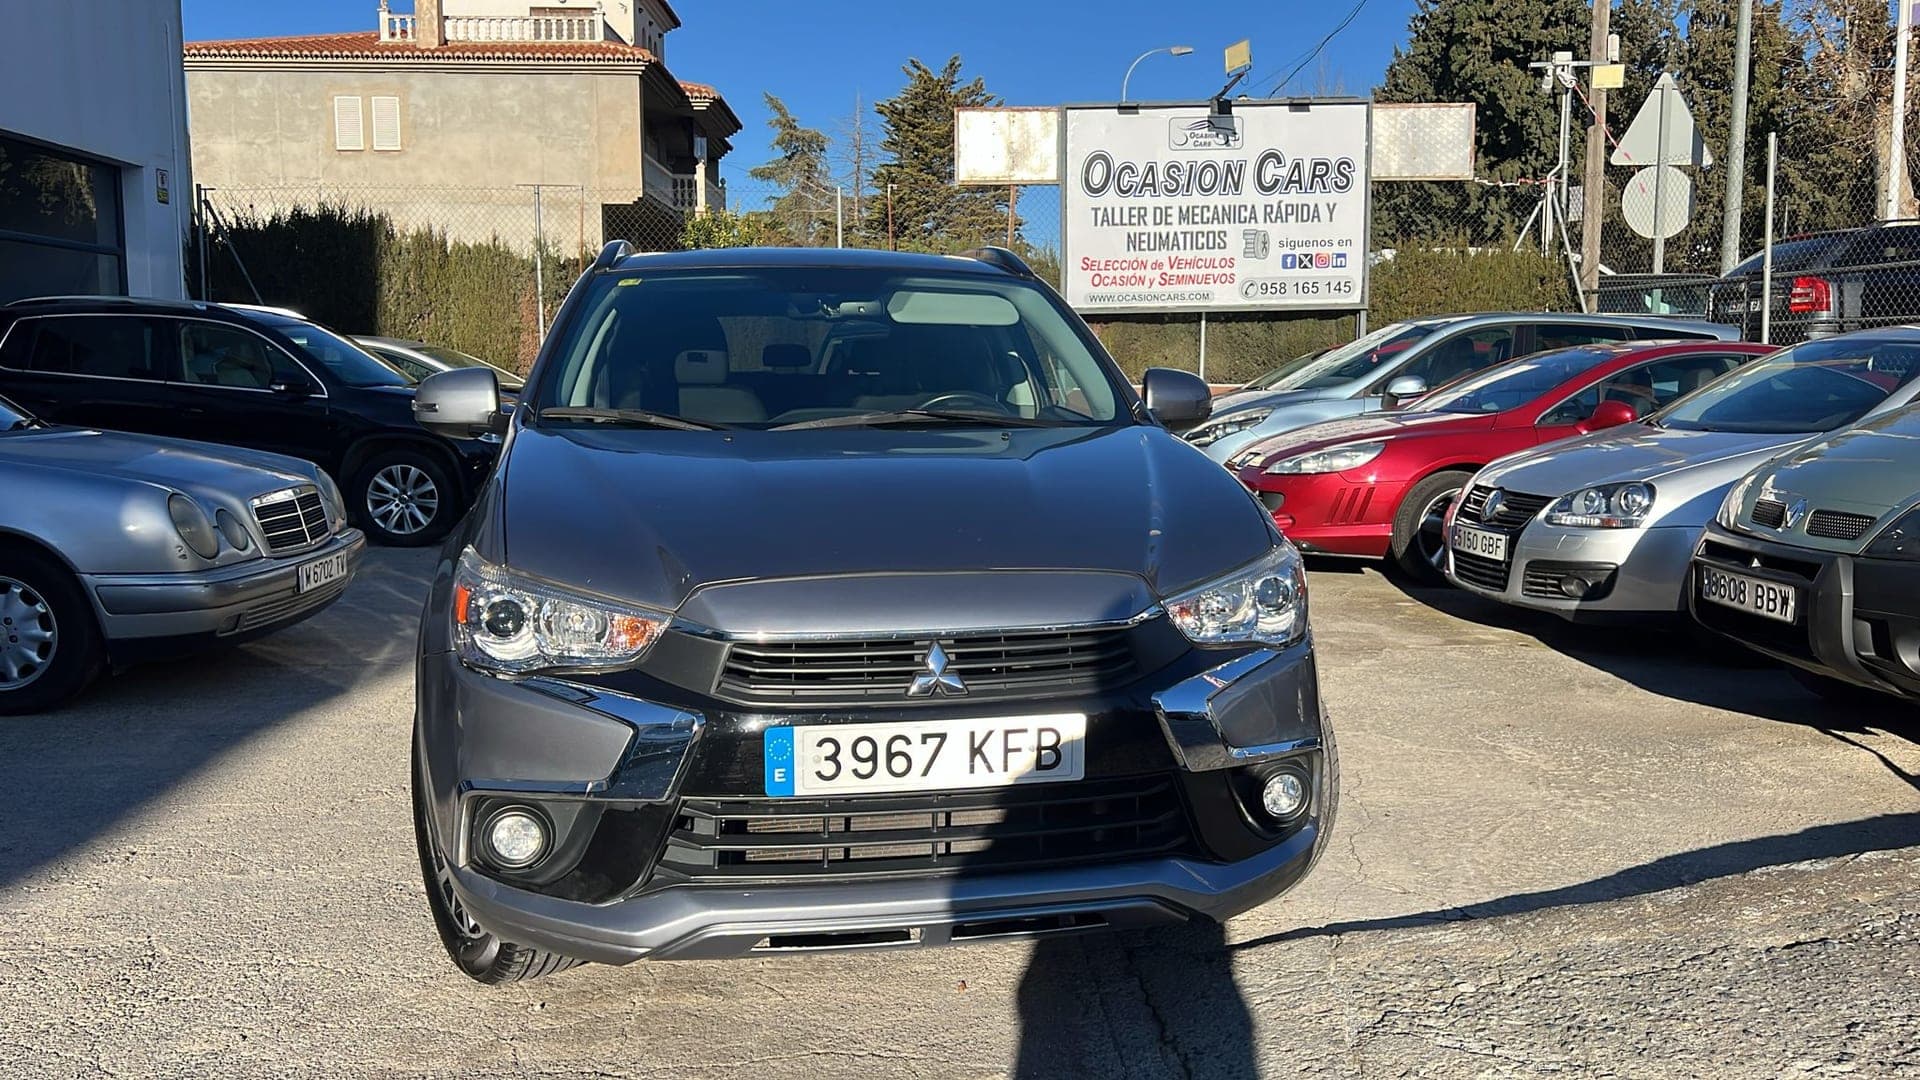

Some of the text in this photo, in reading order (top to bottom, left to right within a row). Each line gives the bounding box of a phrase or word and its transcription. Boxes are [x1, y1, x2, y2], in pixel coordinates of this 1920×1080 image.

[1081, 148, 1355, 198] OCASION CARS
[1091, 200, 1337, 227] TALLER DE MECANICA RÁPIDA Y
[1126, 230, 1227, 252] NEUMATICOS
[1338, 239, 1352, 247] en
[1150, 260, 1164, 270] de
[1148, 278, 1155, 288] y
[1158, 272, 1236, 286] SEMINUEVOS
[1260, 280, 1352, 294] 958 165 145
[1089, 292, 1210, 302] WWW.OCASIONCARS.COM
[1481, 535, 1503, 556] GBF
[313, 559, 333, 583] 6702
[1711, 572, 1790, 617] 8608 BBW
[814, 727, 1062, 782] 3967 KFB
[774, 768, 786, 782] E
